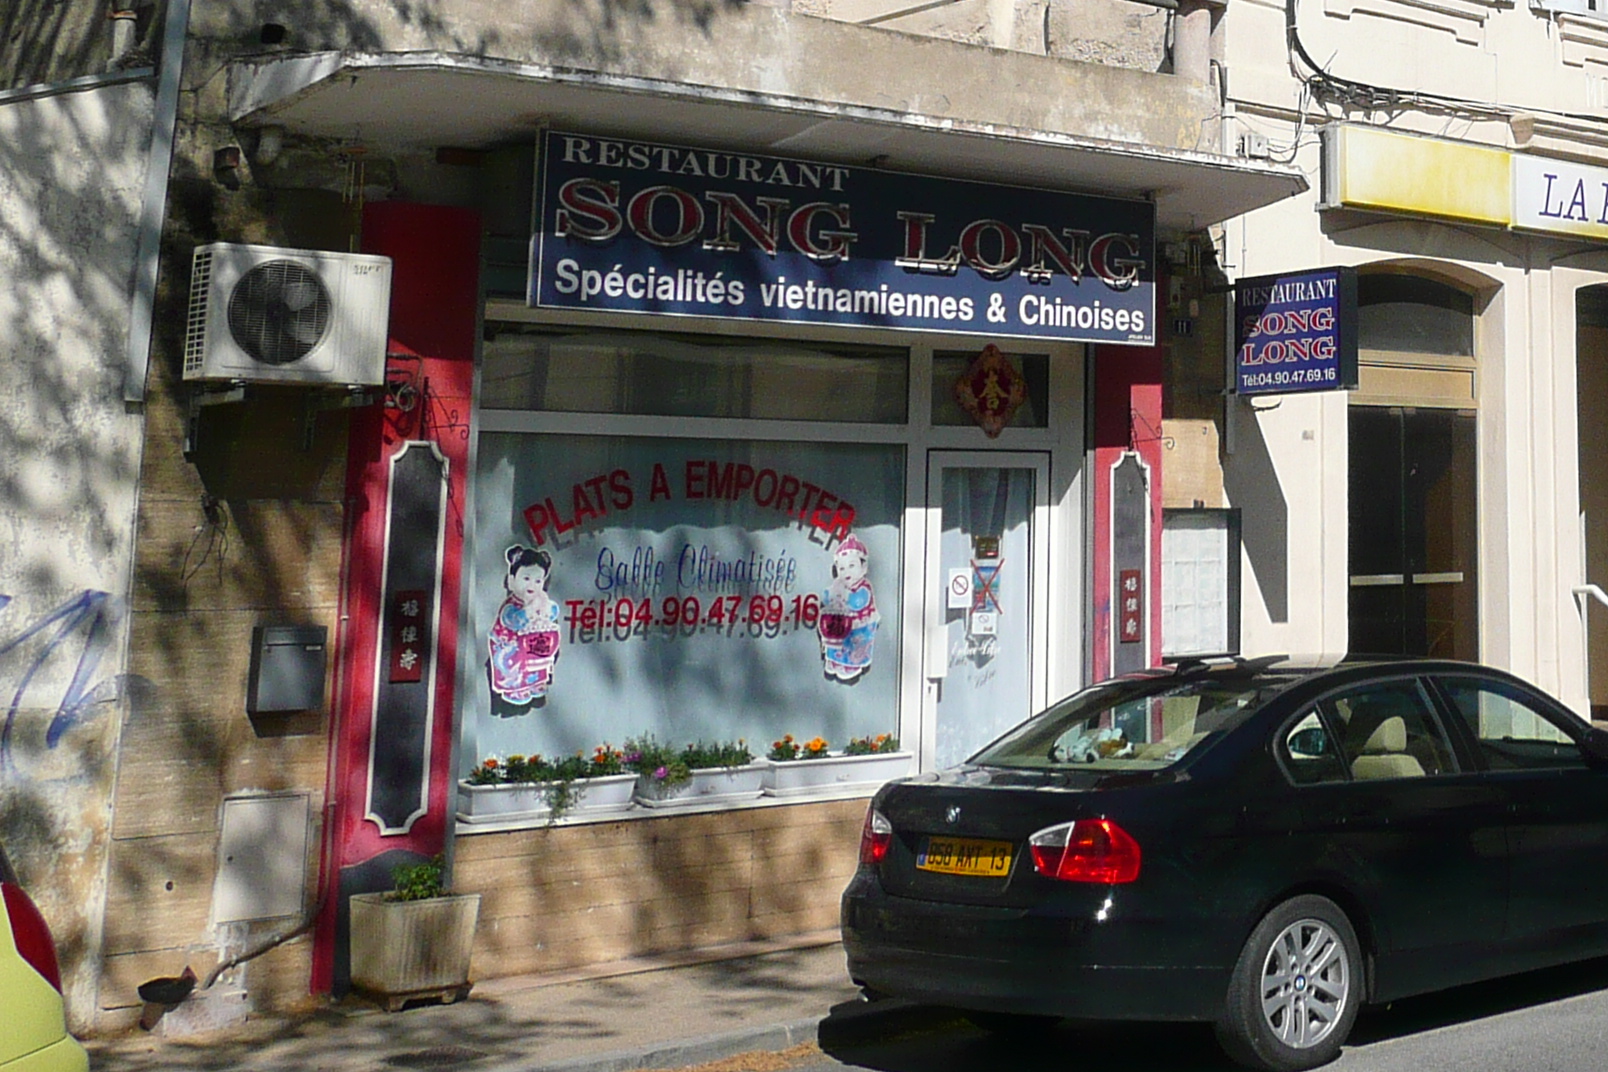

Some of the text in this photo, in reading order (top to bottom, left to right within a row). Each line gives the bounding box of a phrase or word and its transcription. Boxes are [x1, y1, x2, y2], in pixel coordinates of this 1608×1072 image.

[561, 136, 850, 192] RESTAURANT
[1538, 173, 1589, 222] LA
[555, 177, 1147, 290] SONG LONG
[555, 257, 1146, 333] Spécialités vietnamiennes & Chinoises
[1242, 279, 1337, 307] RESTAURANT
[1243, 307, 1335, 338] SONG
[1241, 336, 1336, 366] LONG
[523, 460, 857, 547] PLATS A EMPORTER
[595, 544, 797, 591] Salle Climatisée
[564, 593, 820, 631] Tél:04.90.47.69.16
[991, 846, 1006, 871] 13
